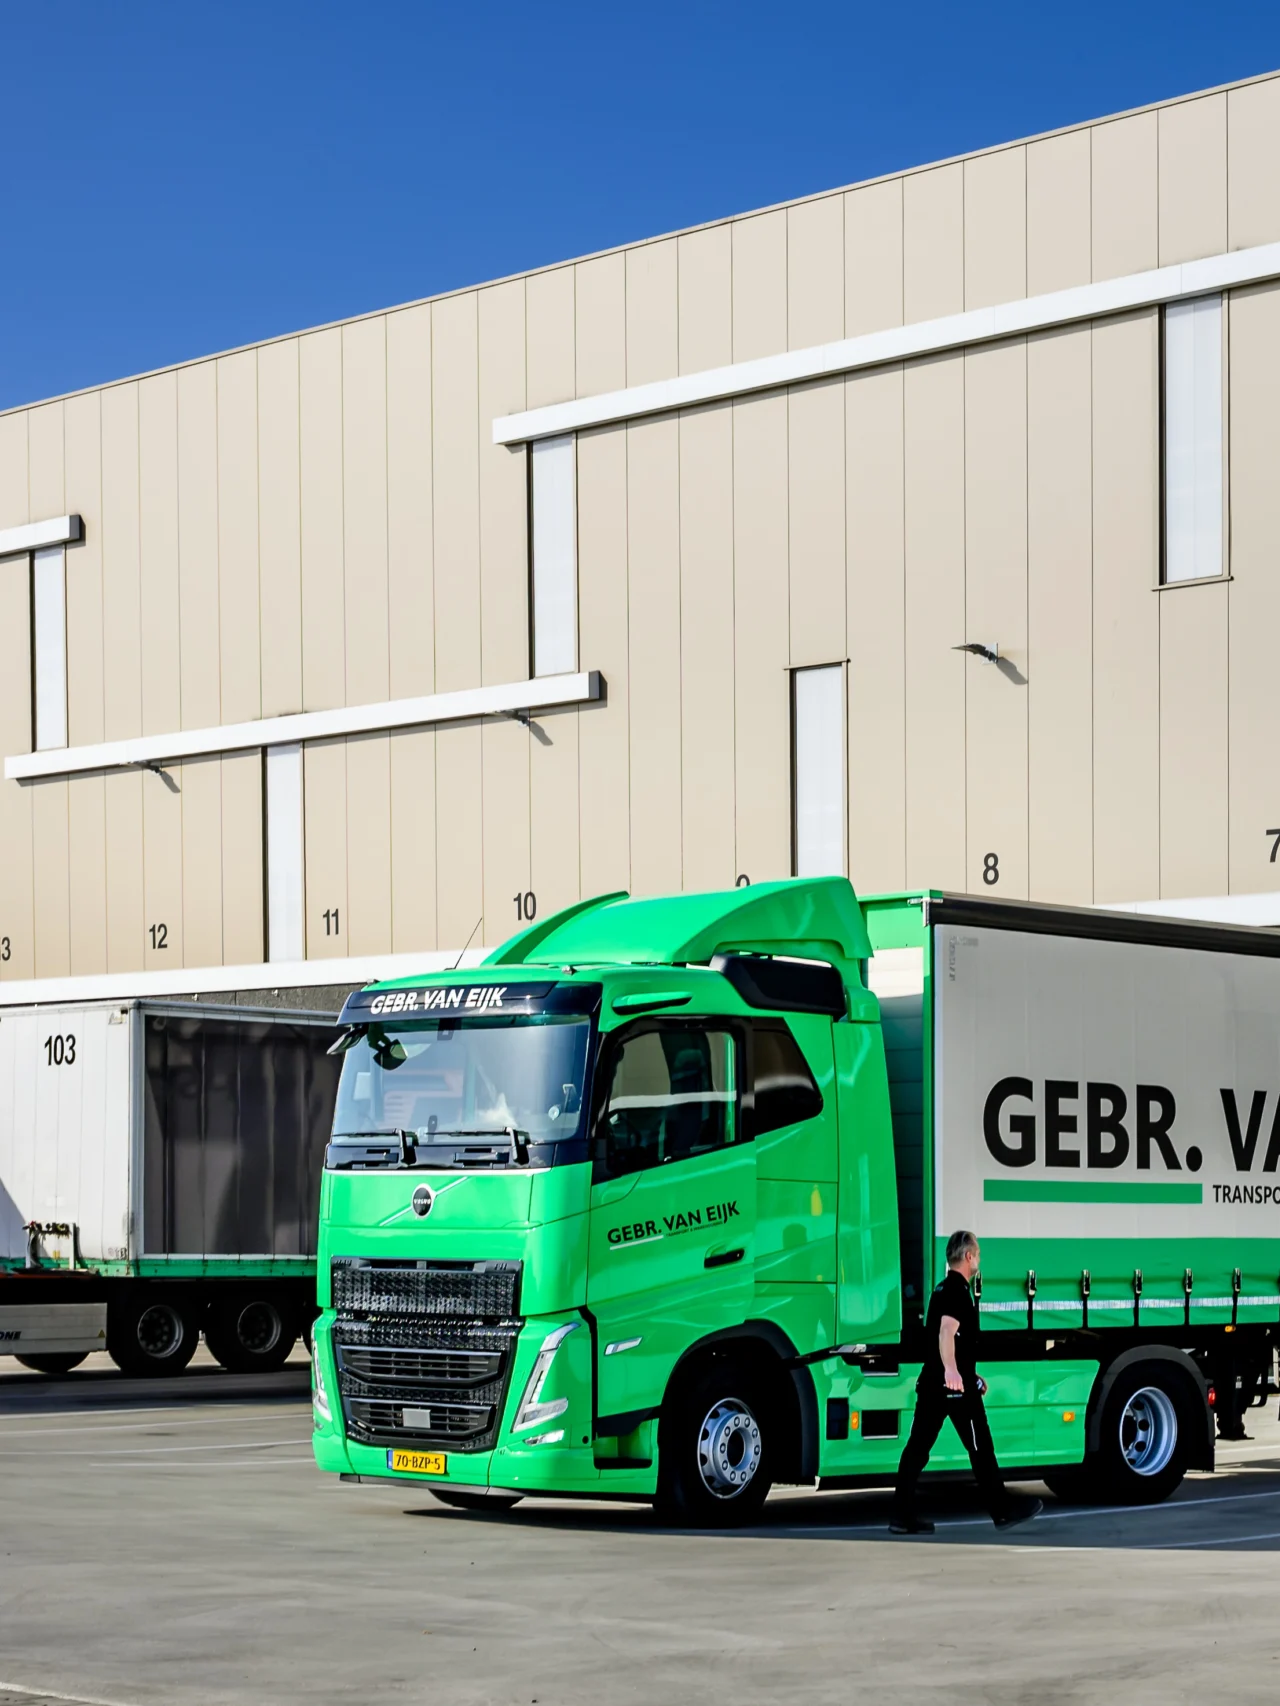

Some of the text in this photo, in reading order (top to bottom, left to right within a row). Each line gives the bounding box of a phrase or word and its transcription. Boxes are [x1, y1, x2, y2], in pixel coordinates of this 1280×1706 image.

[982, 852, 1000, 885] 8
[512, 891, 537, 922] 10
[148, 923, 168, 950] 12
[322, 908, 340, 936] 11
[0, 936, 11, 961] 3
[370, 986, 508, 1015] GEBR. VAN EIJK
[44, 1034, 77, 1066] 103
[983, 1076, 1203, 1172] GEBR.
[607, 1220, 662, 1244] GEBR.
[663, 1209, 702, 1231] VAN
[706, 1200, 740, 1224] EIJK
[396, 1454, 441, 1470] 70-BZP-5
